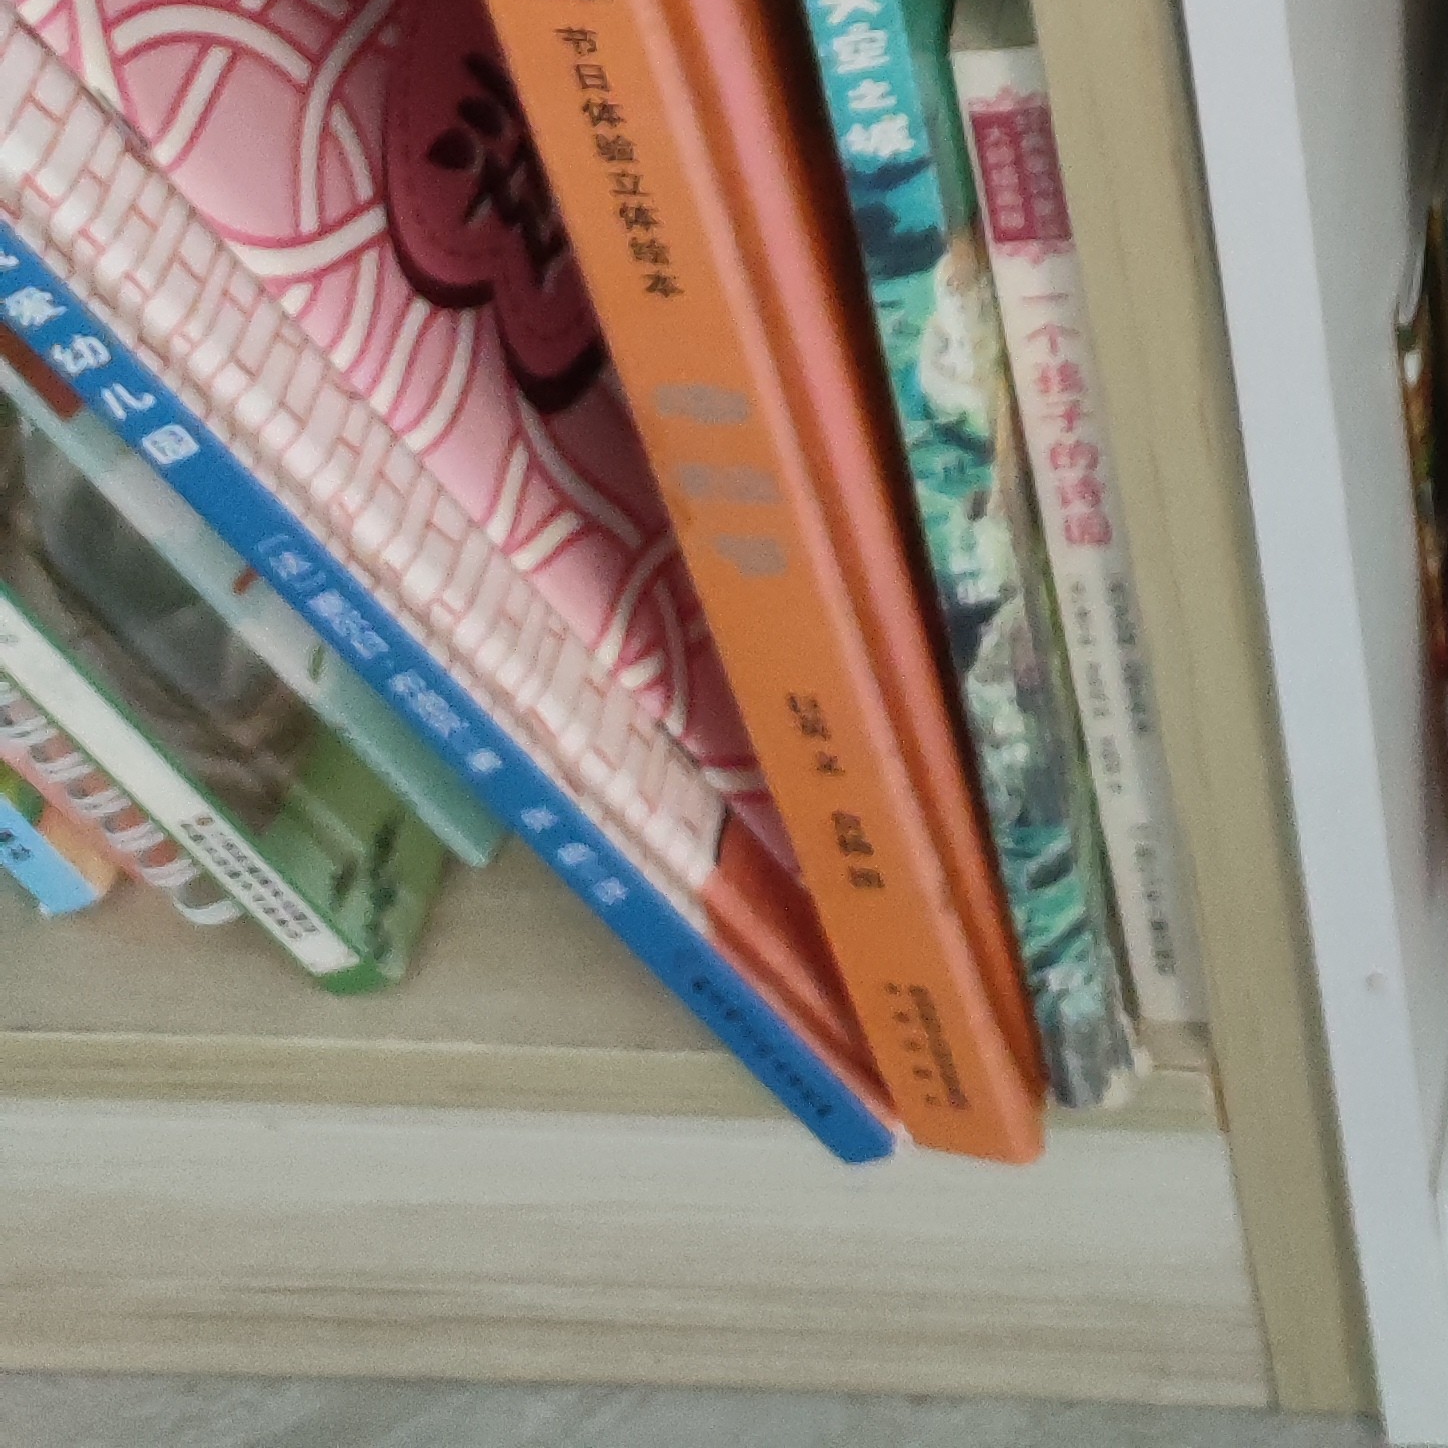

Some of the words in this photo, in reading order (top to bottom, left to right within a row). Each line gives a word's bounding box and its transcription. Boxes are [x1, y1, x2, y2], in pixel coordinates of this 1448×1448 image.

[552, 25, 685, 300] 节日体验立体绘本
